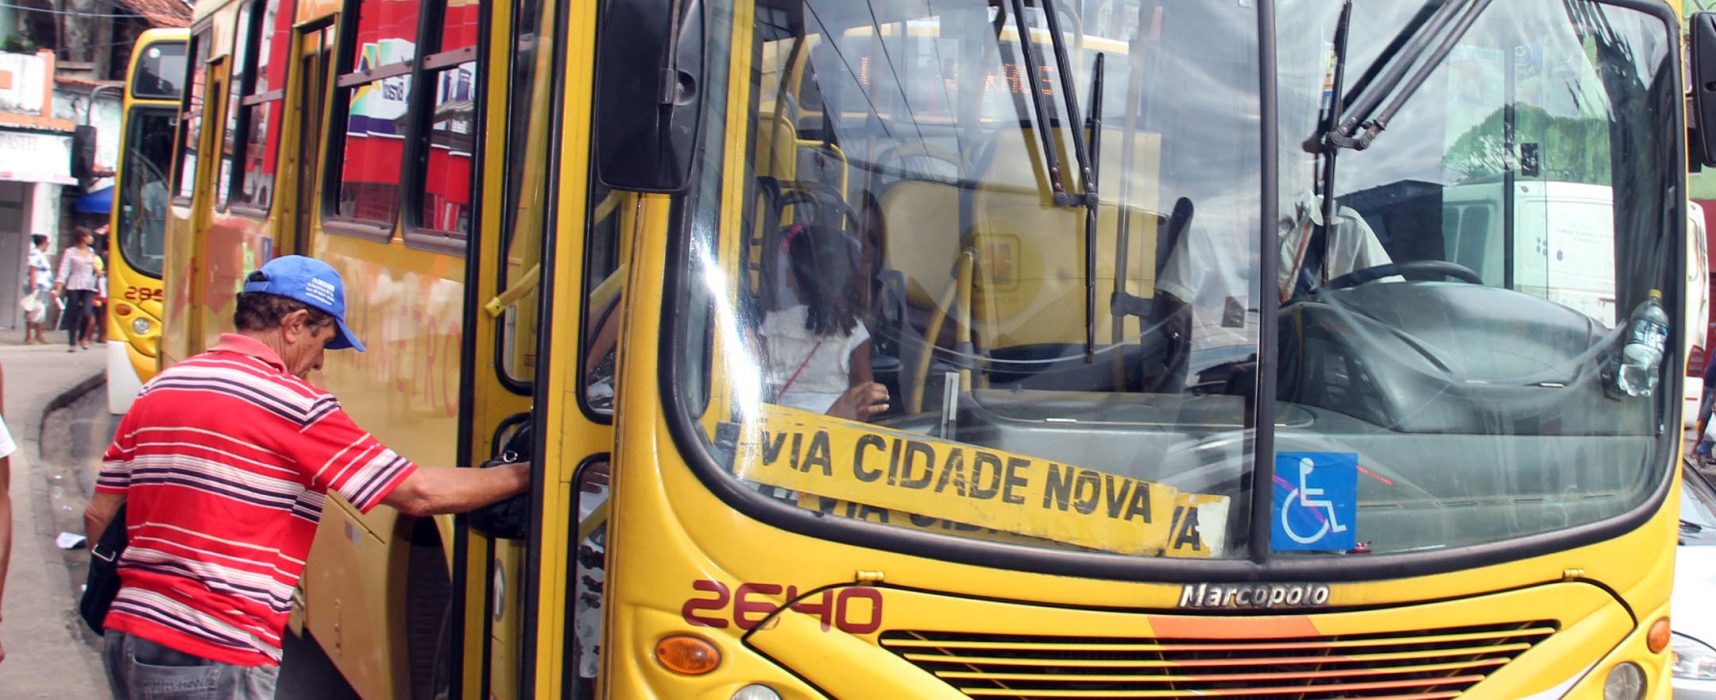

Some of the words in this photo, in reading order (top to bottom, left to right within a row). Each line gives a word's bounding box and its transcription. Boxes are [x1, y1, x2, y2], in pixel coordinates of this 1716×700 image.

[761, 430, 833, 477] VIA
[852, 433, 1032, 505] CIDADE
[1043, 463, 1152, 524] NOVA
[682, 580, 883, 634] 2640
[1179, 583, 1330, 608] Marcopolo
